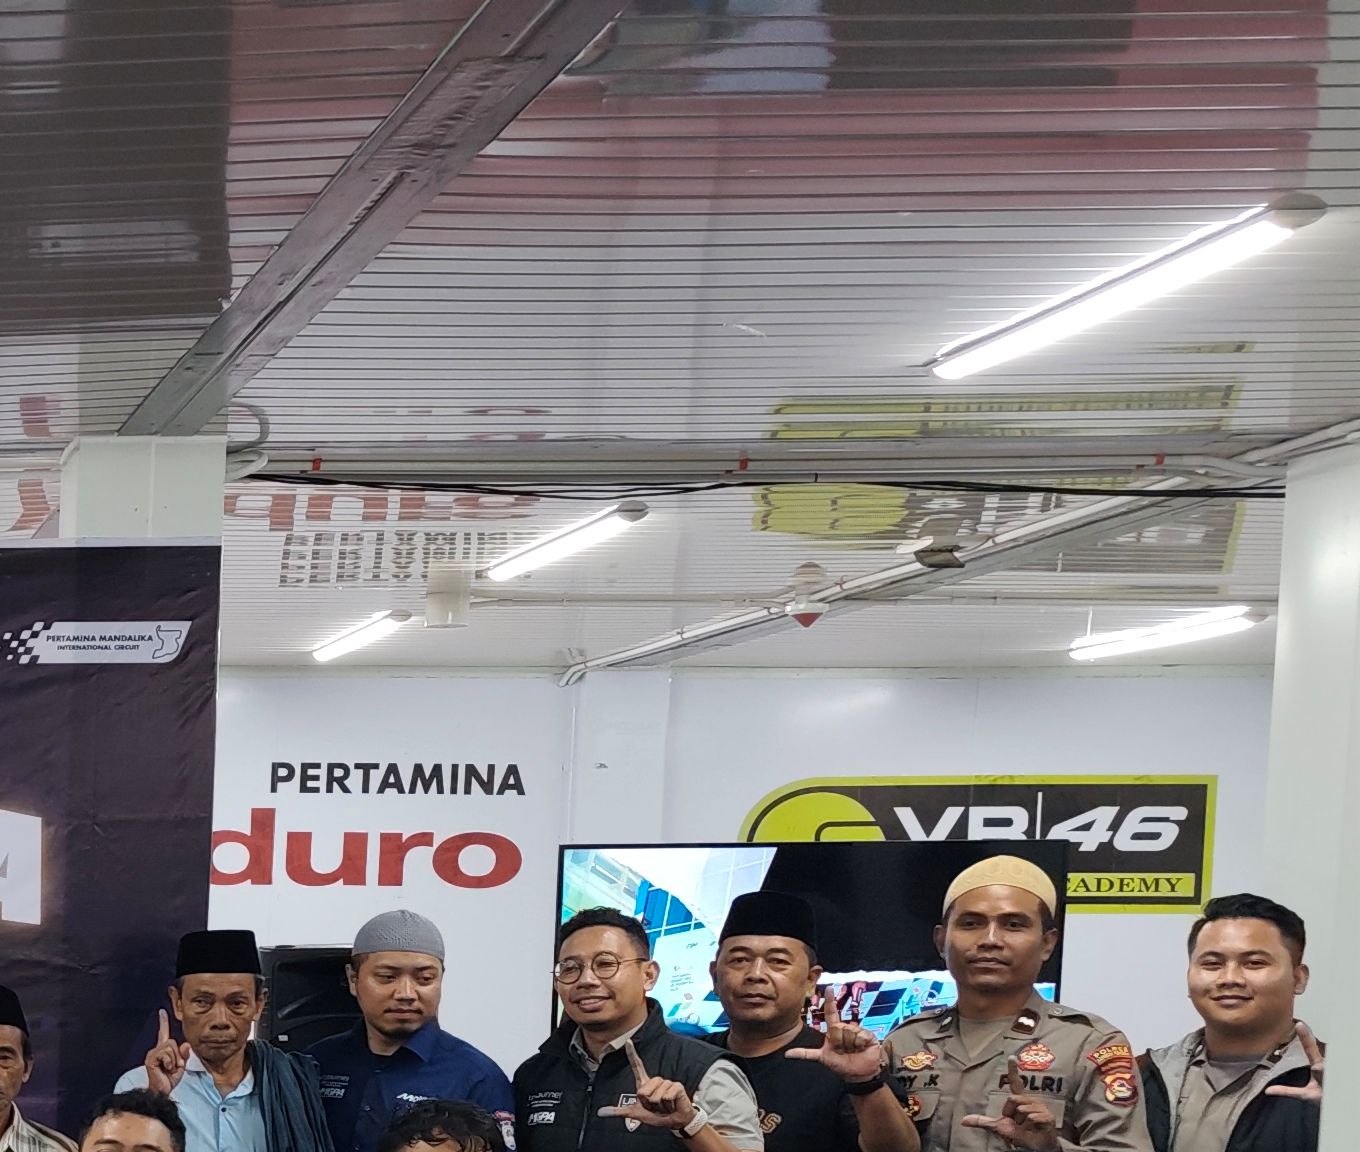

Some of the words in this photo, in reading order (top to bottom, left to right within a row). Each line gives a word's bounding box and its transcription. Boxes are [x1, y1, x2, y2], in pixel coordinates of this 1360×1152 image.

[46, 634, 96, 643] PERTAMINA
[98, 634, 154, 642] MANDALIKA
[269, 761, 526, 796] PERTAMINA
[210, 807, 523, 889] duro
[1041, 806, 1189, 851] 46
